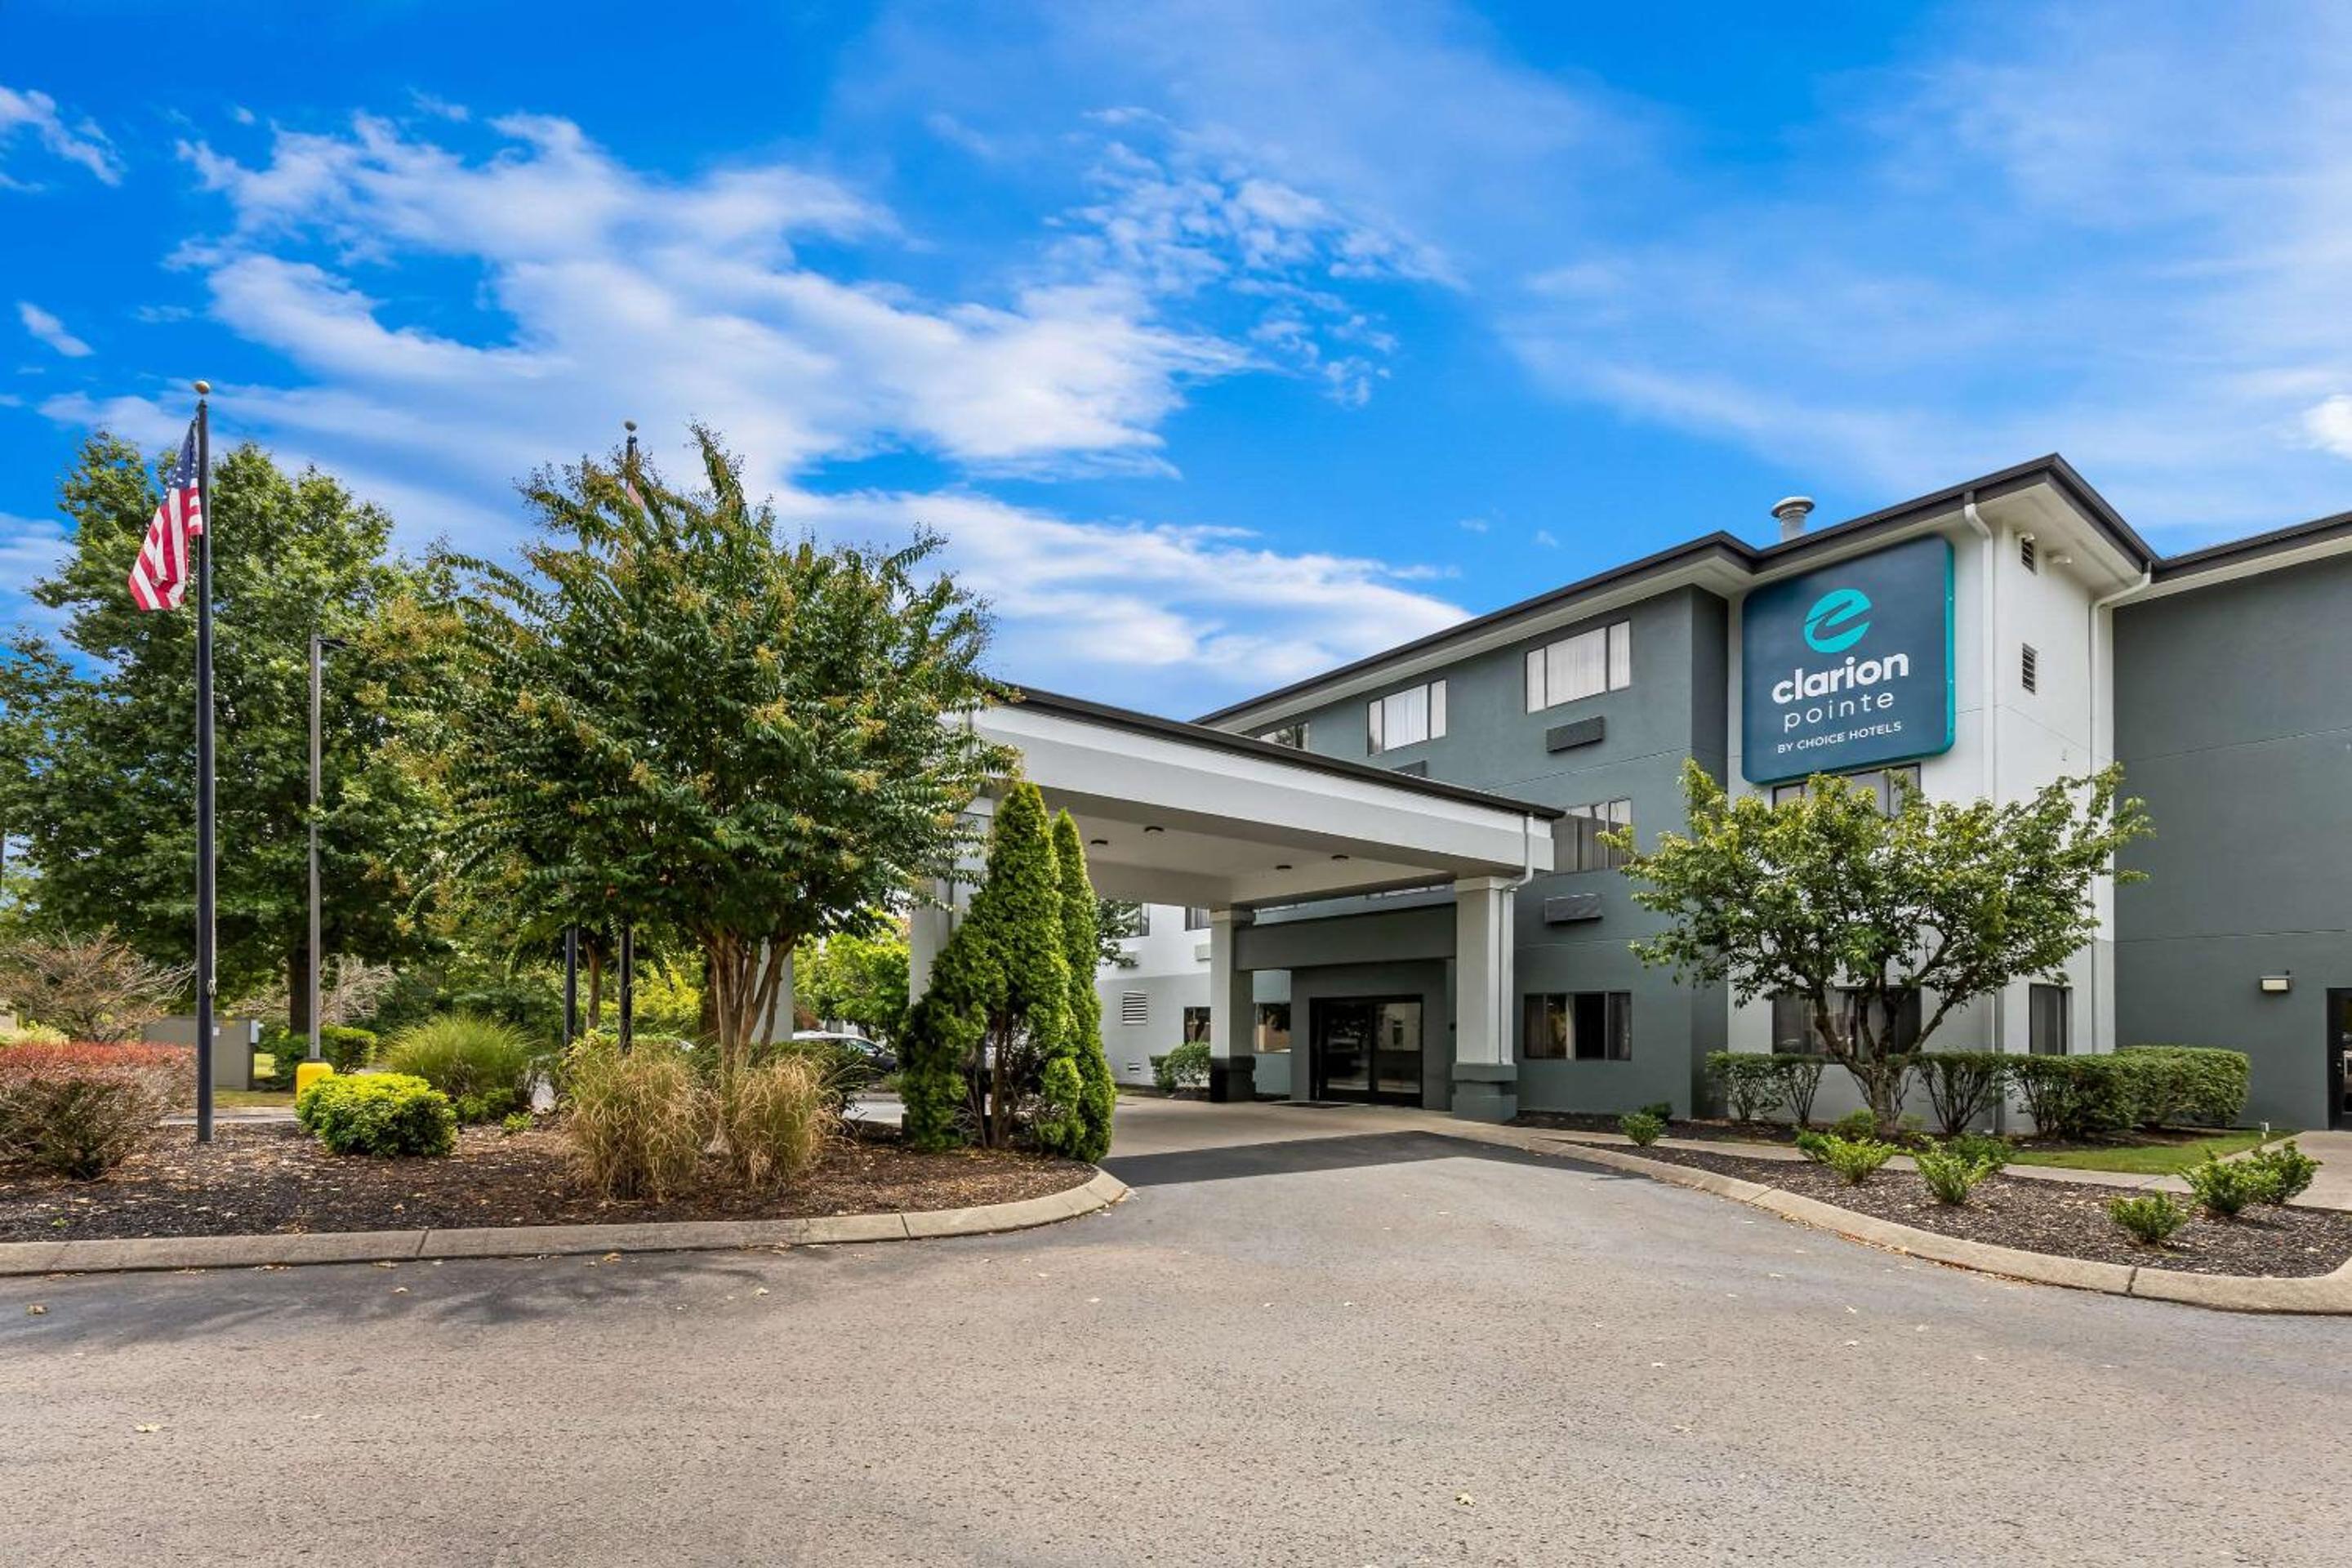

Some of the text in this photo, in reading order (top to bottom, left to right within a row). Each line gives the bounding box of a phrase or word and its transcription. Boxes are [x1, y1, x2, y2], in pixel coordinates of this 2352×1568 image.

[1771, 653, 1909, 704] clarion
[1784, 692, 1895, 733] pointe
[1777, 721, 1902, 754] BY CHOICE HOTELS
